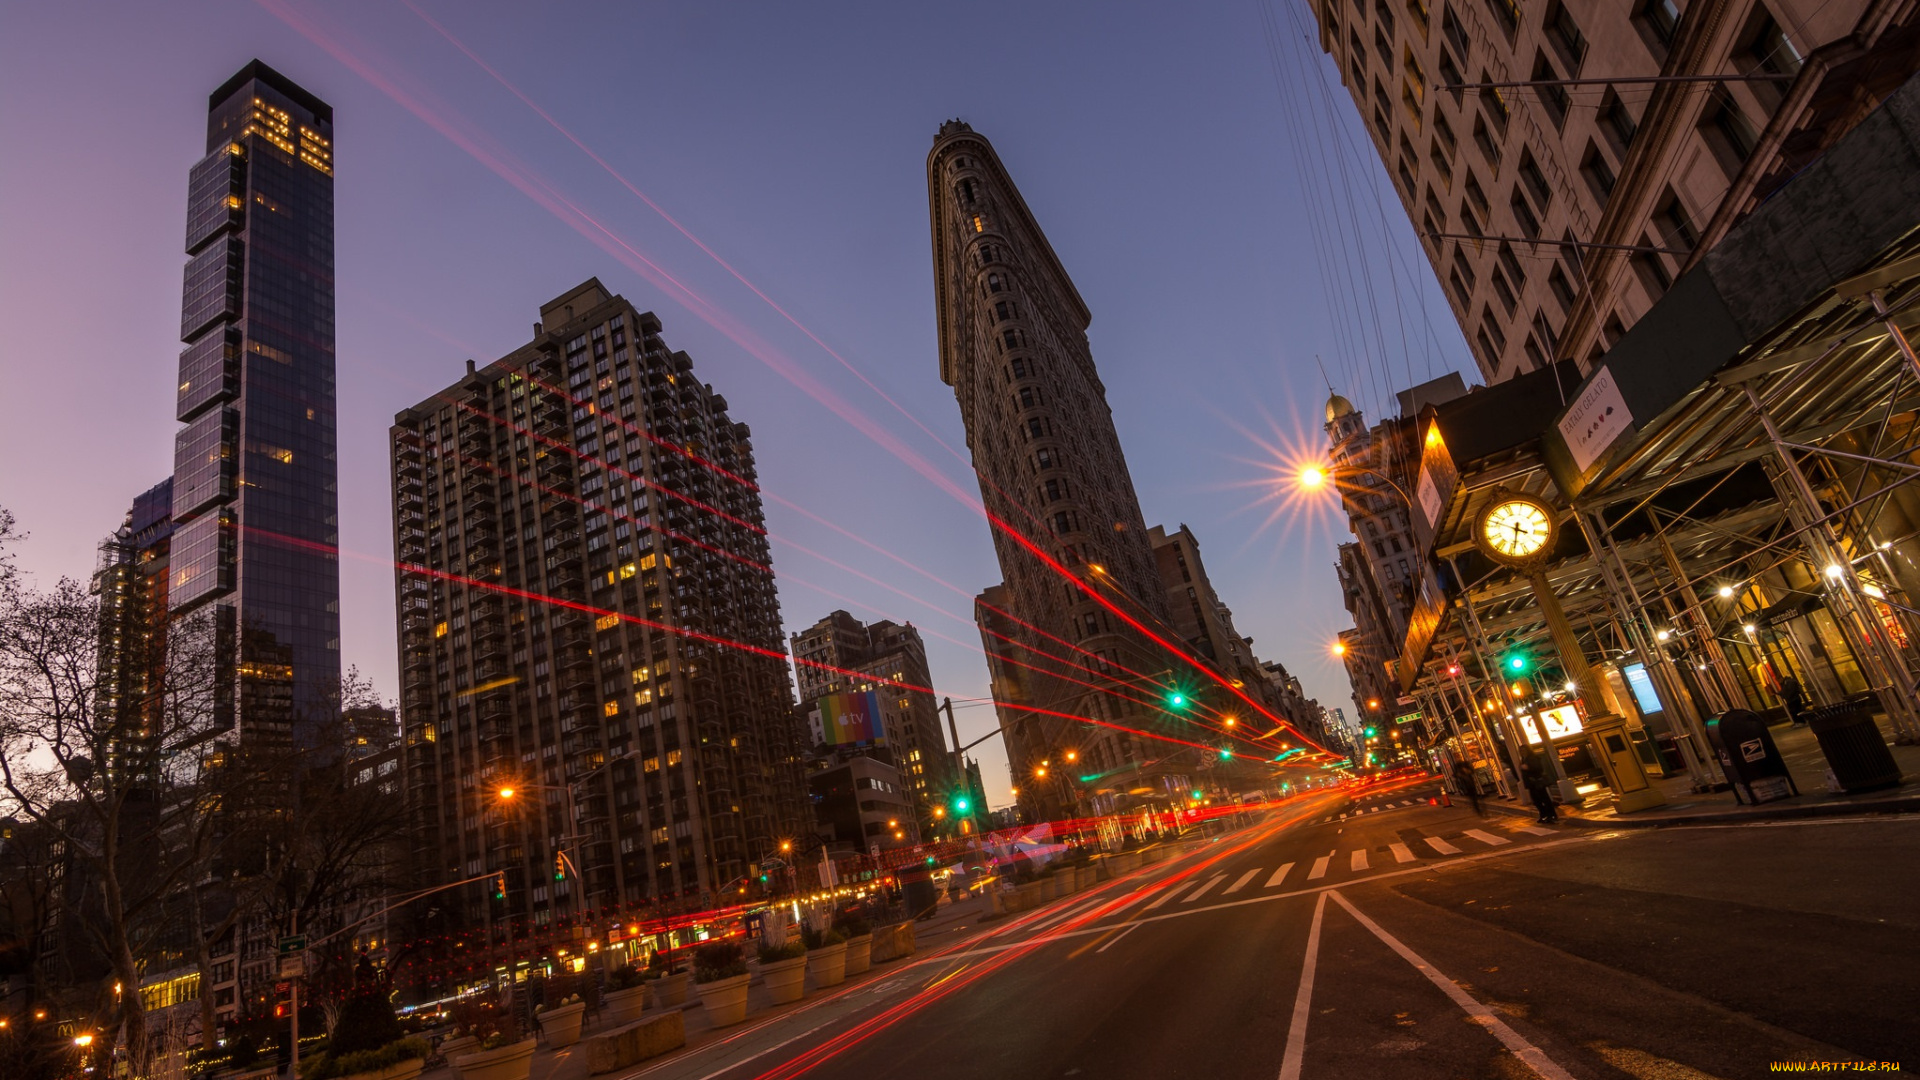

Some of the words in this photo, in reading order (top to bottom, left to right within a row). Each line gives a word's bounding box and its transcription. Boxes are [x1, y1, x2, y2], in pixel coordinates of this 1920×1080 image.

[1564, 405, 1584, 434] EATALY
[1582, 377, 1607, 410] GELATO
[849, 712, 864, 724] tv
